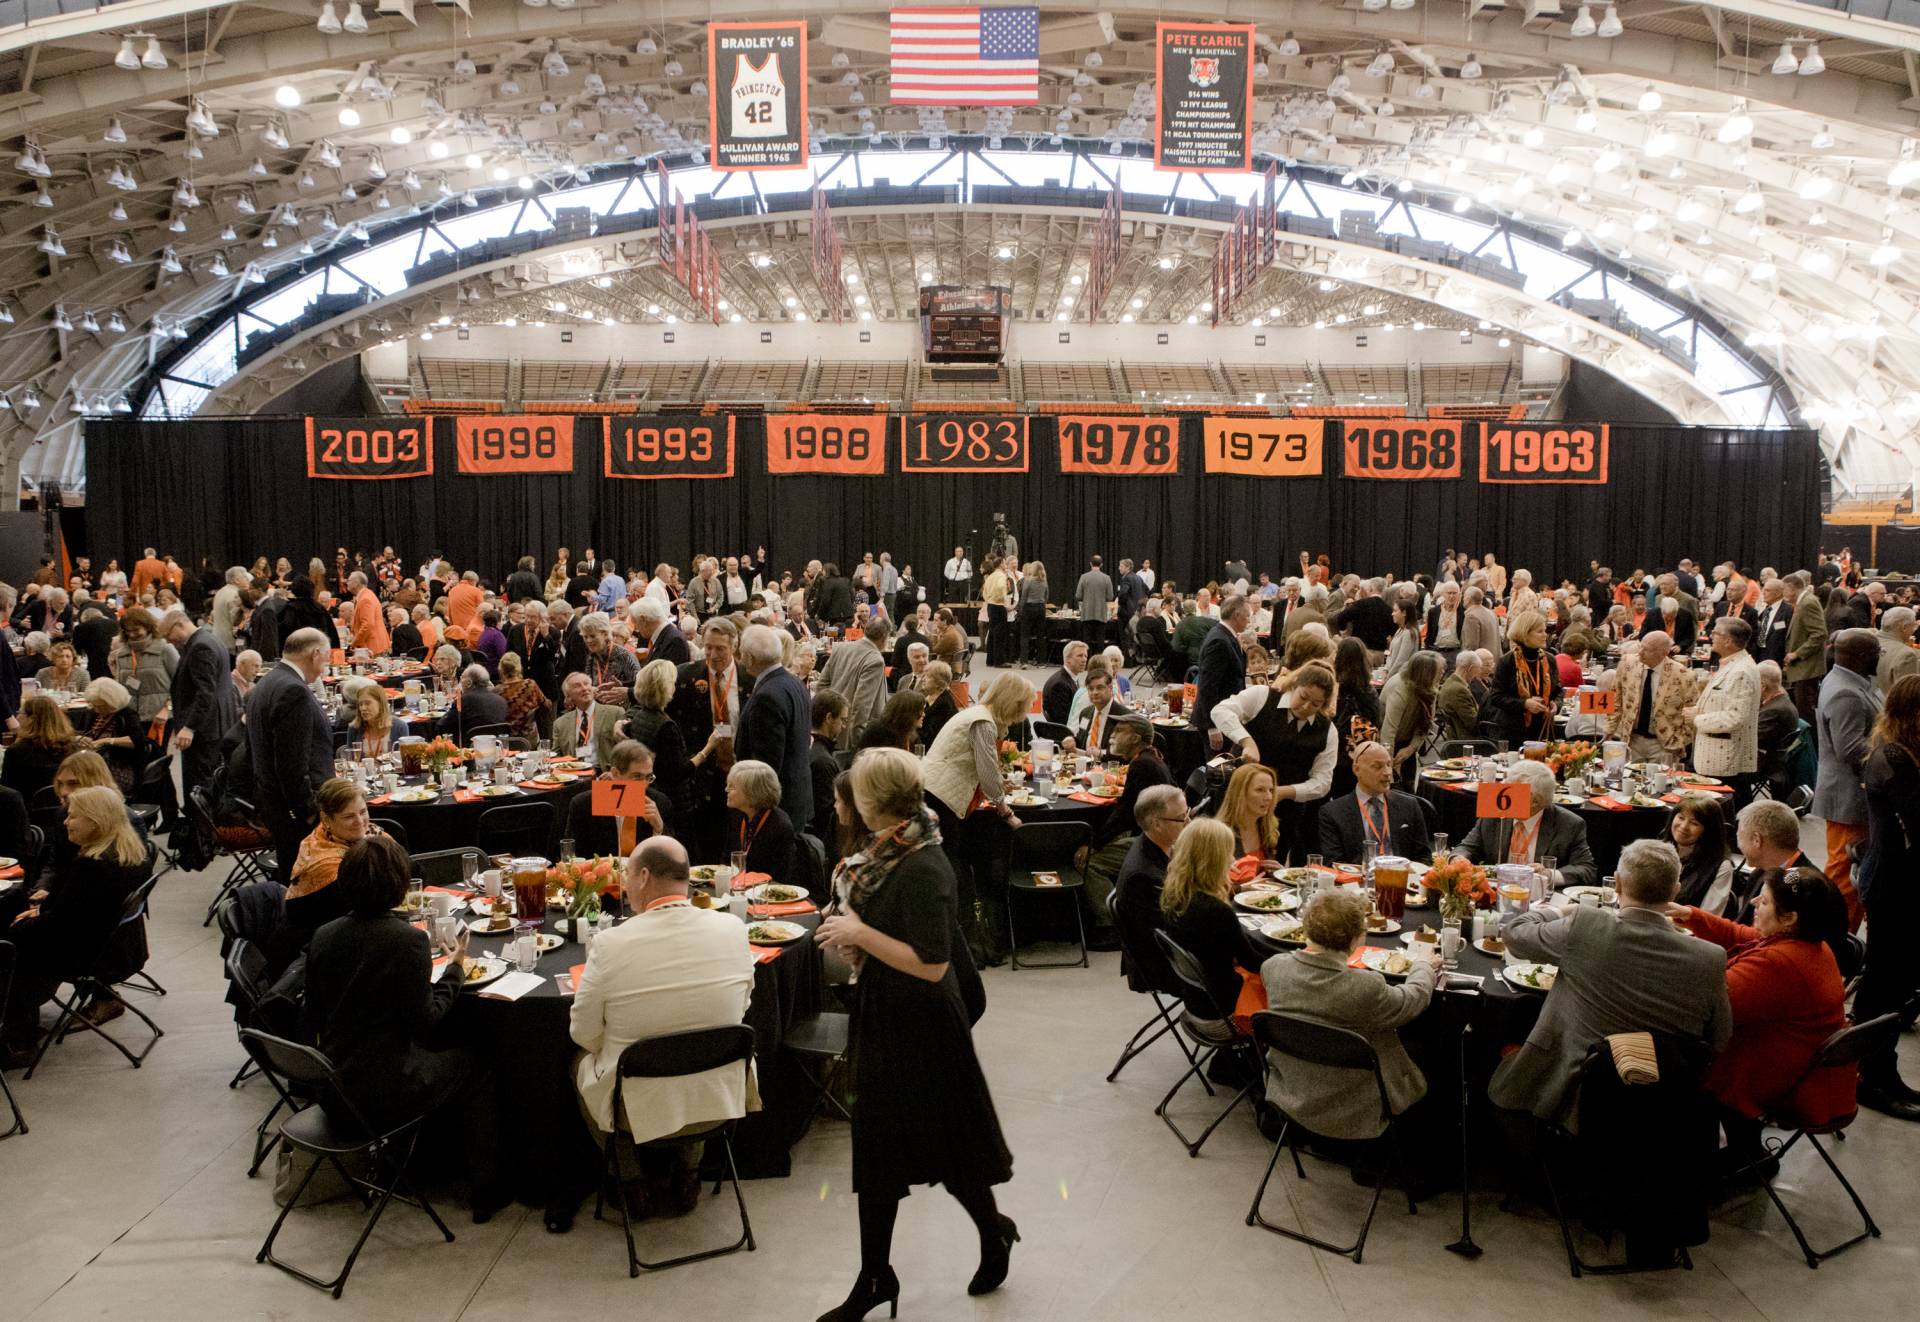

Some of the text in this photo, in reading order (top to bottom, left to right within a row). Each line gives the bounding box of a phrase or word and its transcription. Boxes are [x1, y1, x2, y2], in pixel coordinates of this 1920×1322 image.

[721, 36, 795, 49] BRADLEY '65
[1166, 34, 1245, 46] PETE CARRIL
[735, 83, 781, 98] PRINCETON
[744, 101, 772, 123] 42
[1201, 101, 1228, 109] LEAGUE
[1200, 121, 1236, 129] CHAMPION
[720, 142, 799, 153] SULLIVAN AWARD
[729, 153, 790, 163] WINNER 1965
[1164, 148, 1196, 156] NAISMITH
[320, 428, 419, 462] 2003
[471, 426, 556, 460] 1998
[624, 427, 713, 462] 1993
[783, 426, 870, 460] 1988
[913, 420, 1019, 462] 1983
[1062, 425, 1171, 466] 1978
[1218, 431, 1307, 463] 1973
[1347, 427, 1456, 468] 1968
[1490, 428, 1594, 471] 1963
[1587, 693, 1608, 709] 14
[610, 784, 626, 809] 7
[1496, 785, 1512, 810] 6
